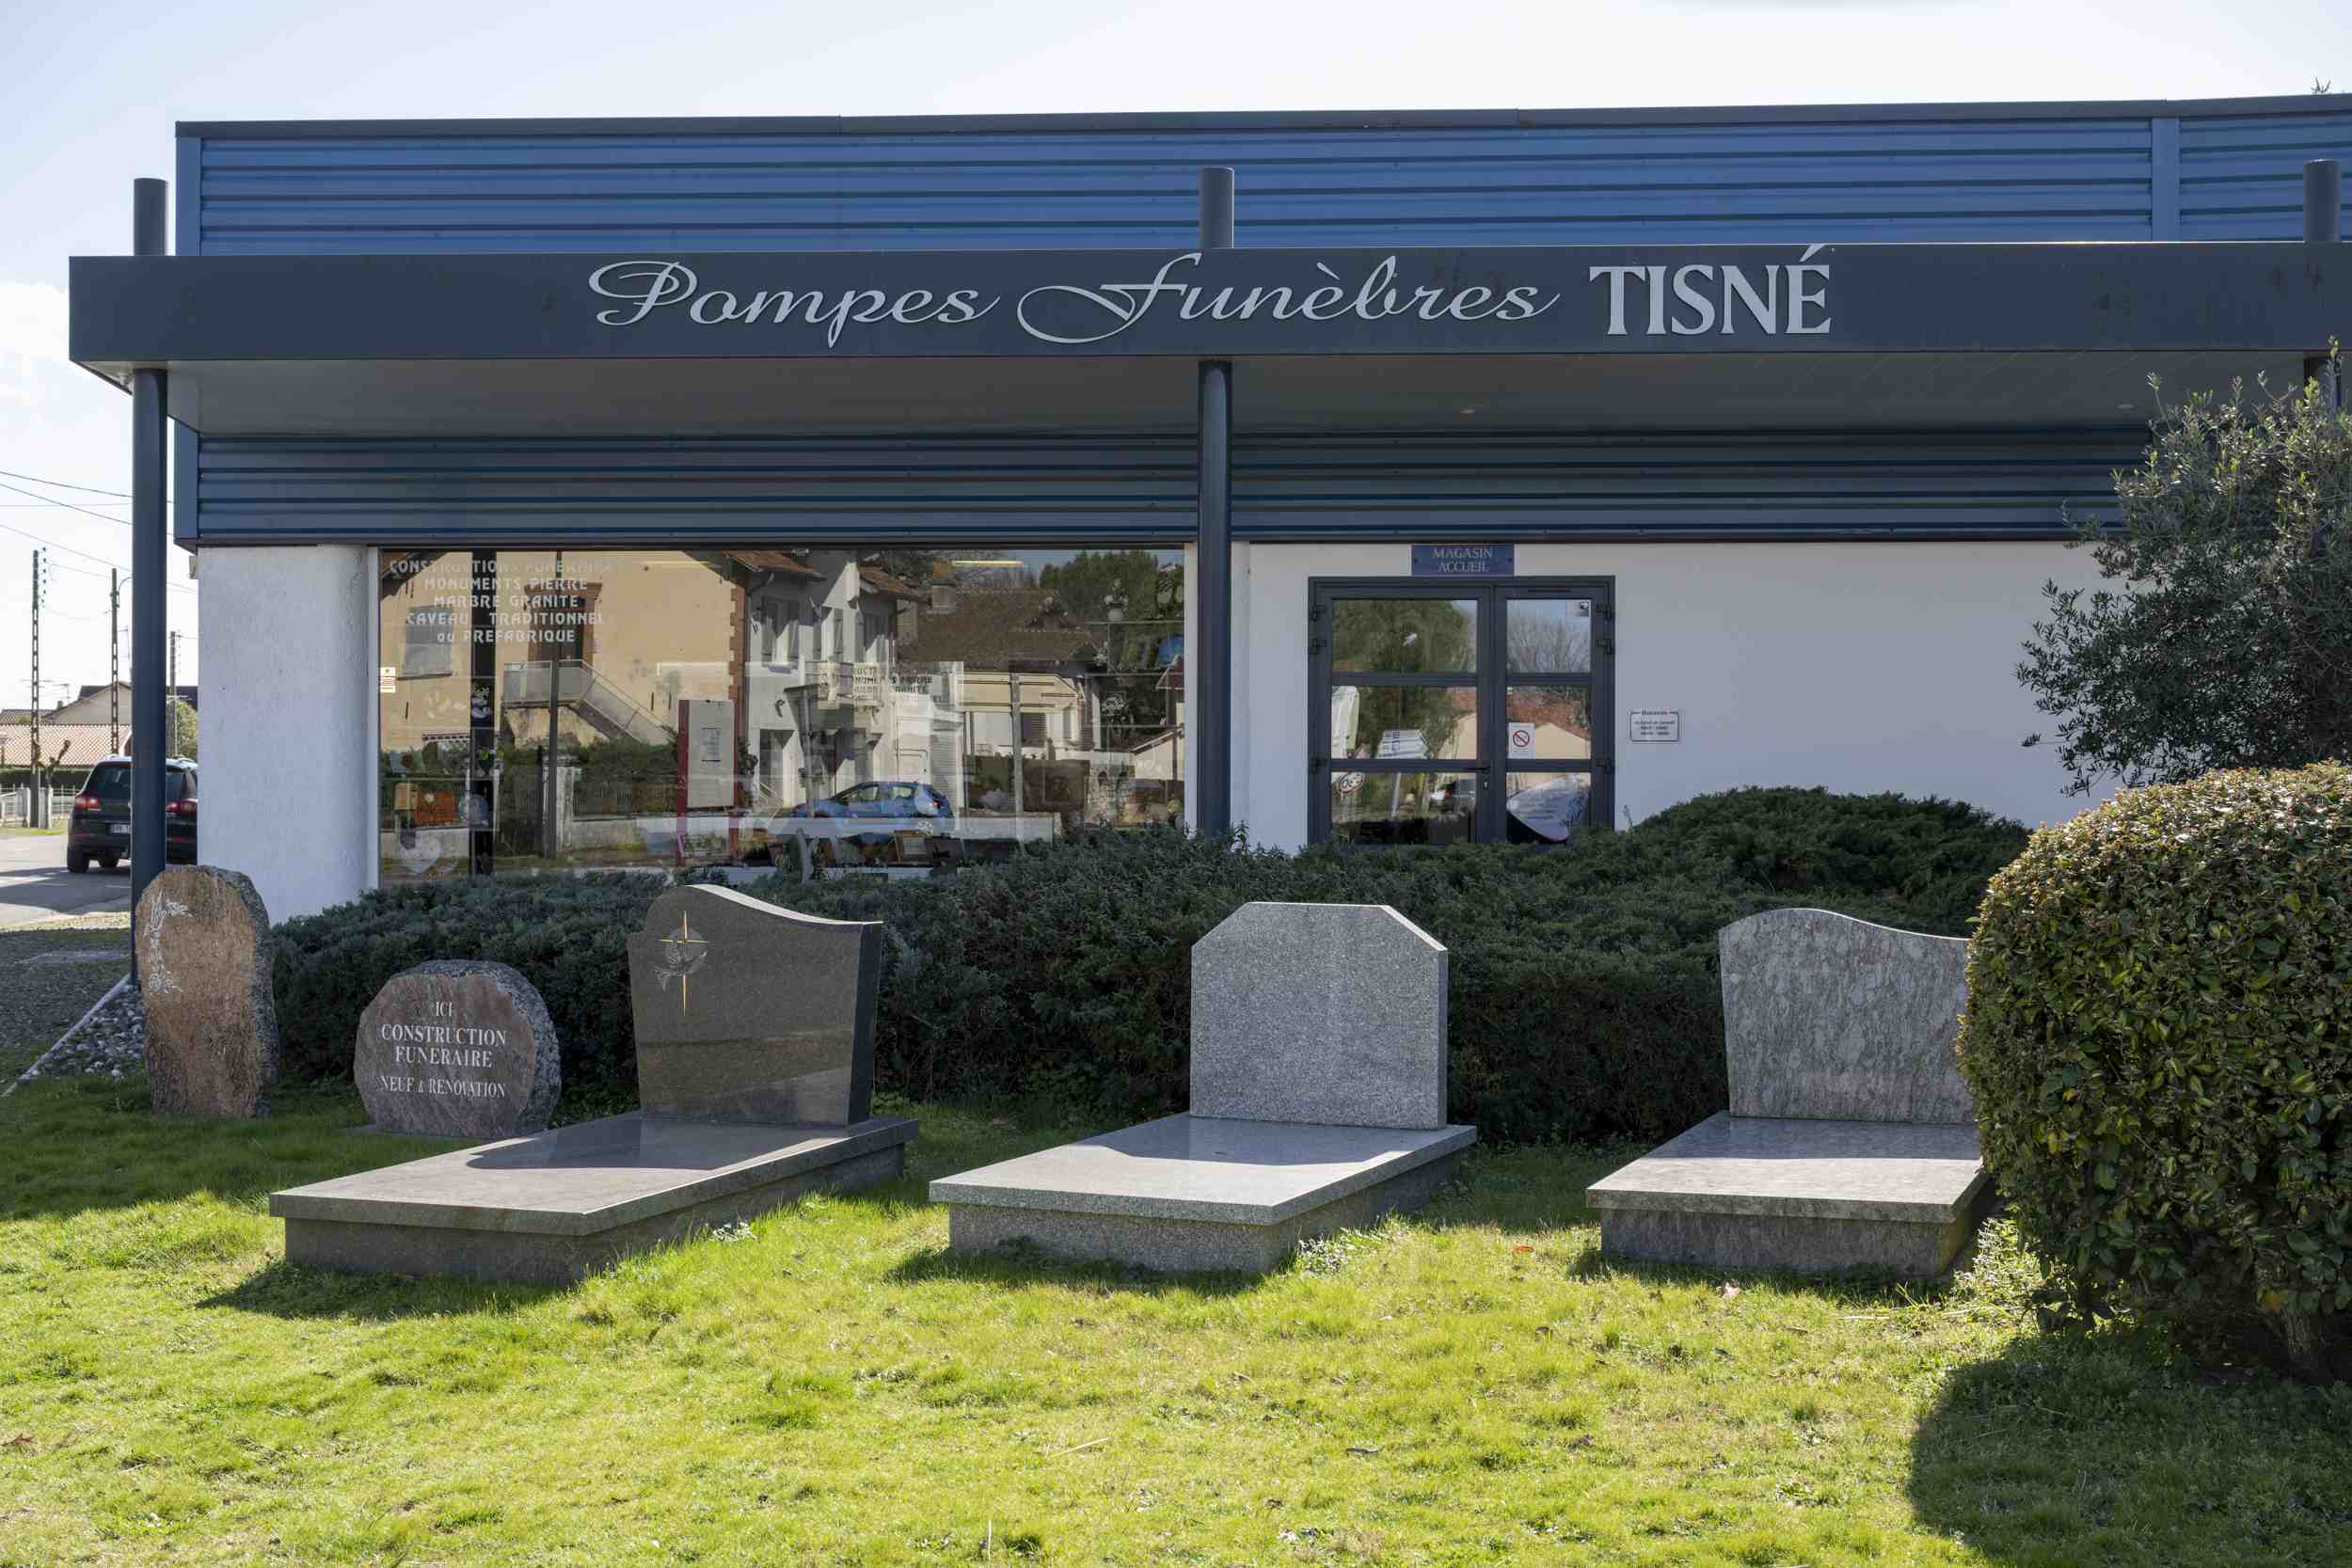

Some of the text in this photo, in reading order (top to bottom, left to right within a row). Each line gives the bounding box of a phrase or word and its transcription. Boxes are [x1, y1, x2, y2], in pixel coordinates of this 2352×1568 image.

[589, 244, 1832, 348] Pompes Funèbres TISNÉ
[1432, 548, 1493, 558] MAGASIN
[1438, 562, 1489, 572] ACCUEIL
[424, 577, 588, 591] MONUMENTS PIERRE
[434, 594, 579, 609] MARBRE GRANITE
[406, 612, 604, 626] CAVEAU TRADITIONNEL
[463, 629, 576, 643] PREFABRIQUE
[436, 1001, 453, 1017] ICI
[381, 1023, 507, 1047] CONSTRUCTION
[395, 1046, 493, 1069] FUNERAIRE
[380, 1075, 415, 1092] NEUF
[429, 1078, 506, 1099] RENOVATION
